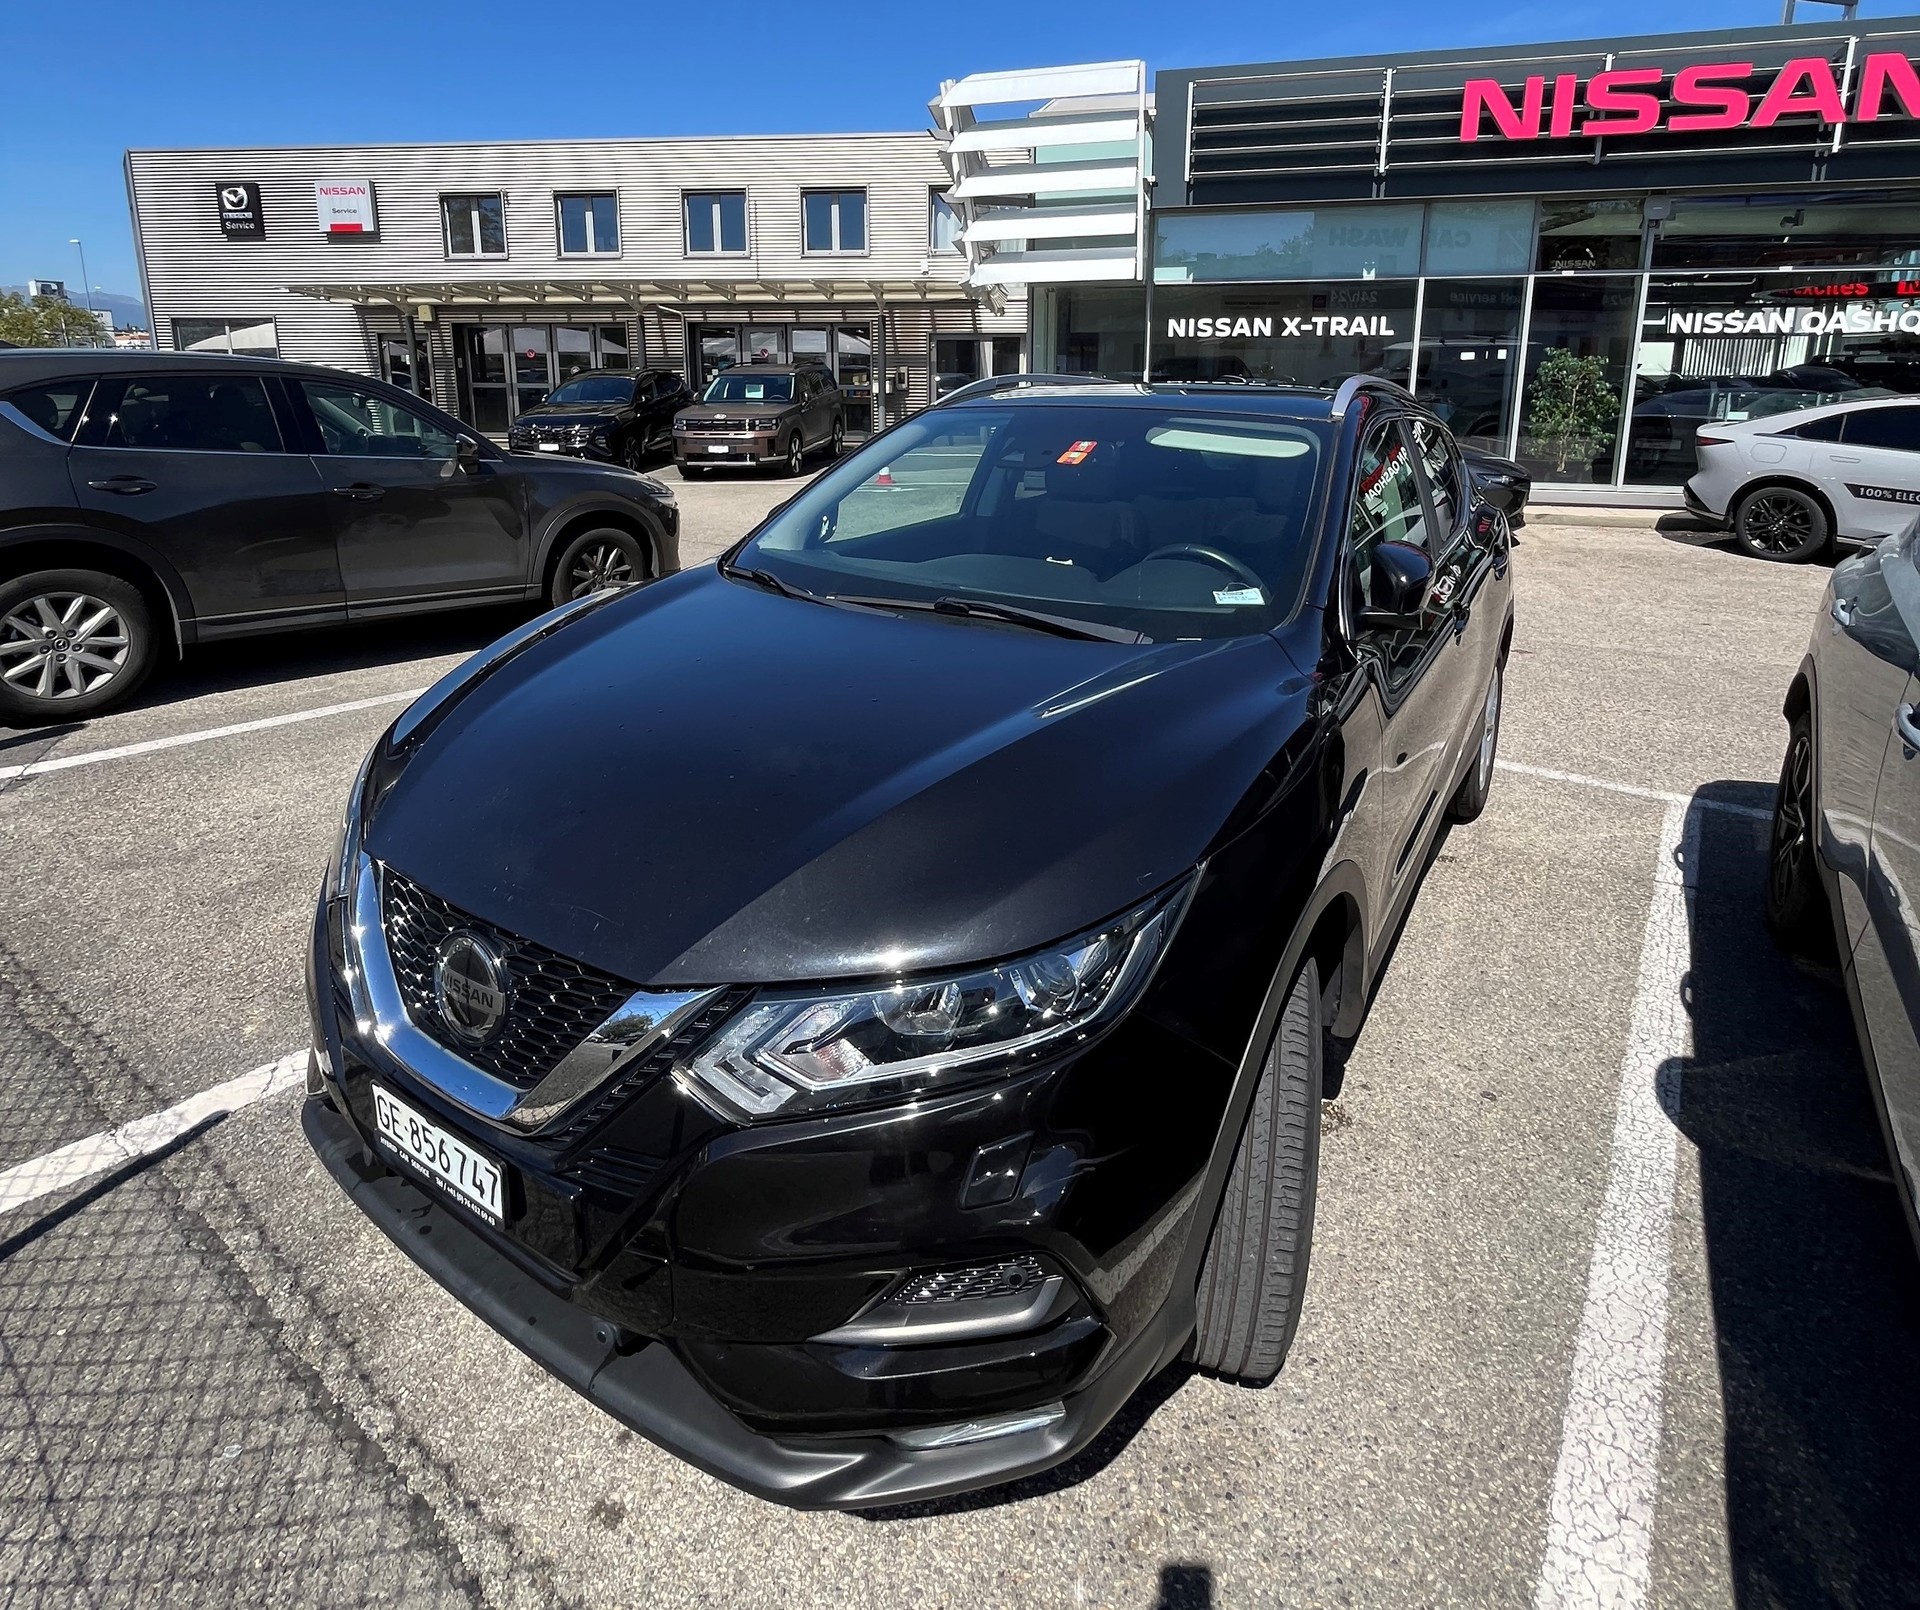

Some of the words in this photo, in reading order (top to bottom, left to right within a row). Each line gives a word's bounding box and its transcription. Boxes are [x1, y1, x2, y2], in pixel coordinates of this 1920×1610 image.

[1459, 52, 1920, 142] NISSAN
[319, 186, 366, 196] NISSAN
[225, 220, 255, 230] Service
[1554, 259, 1597, 268] NISSAN
[1167, 316, 1272, 338] NISSAN
[1281, 316, 1395, 337] X-TRAIL
[1669, 309, 1791, 334] NISSAN
[1860, 487, 1892, 499] 100%
[442, 969, 494, 1009] NISSAN
